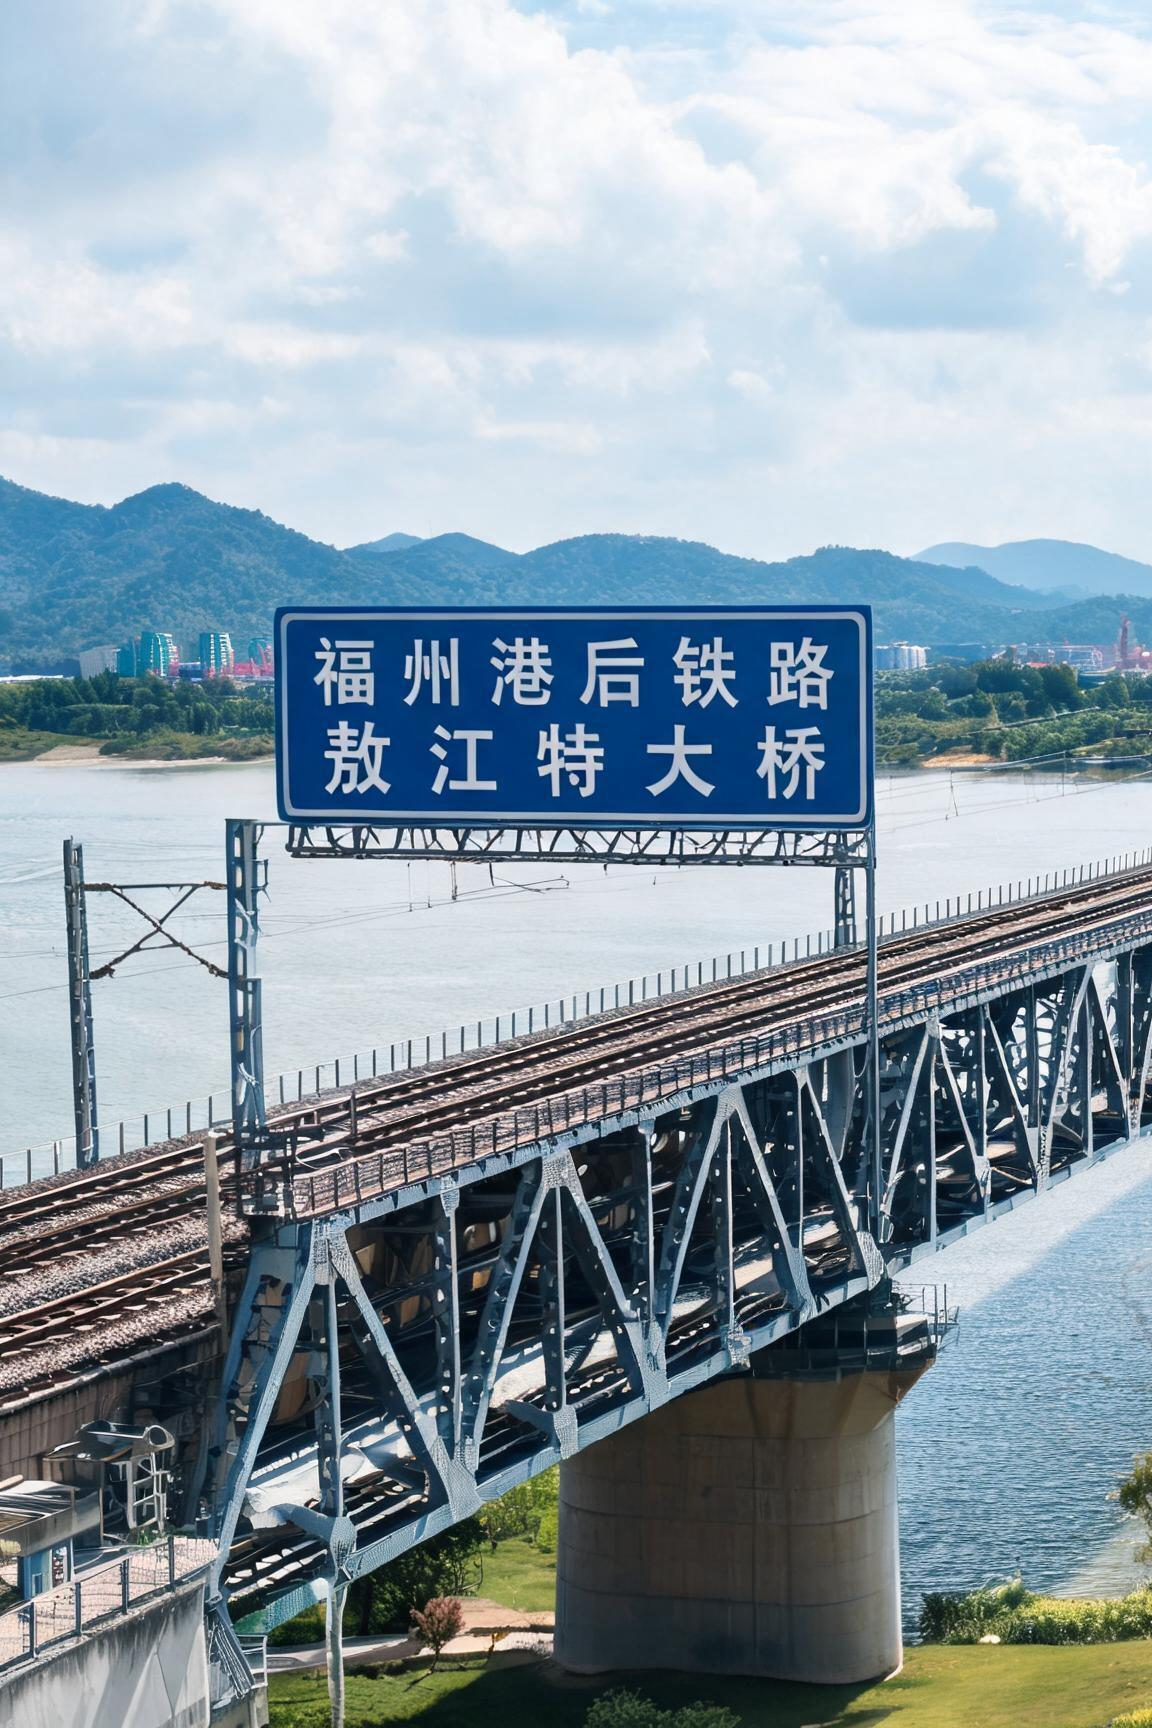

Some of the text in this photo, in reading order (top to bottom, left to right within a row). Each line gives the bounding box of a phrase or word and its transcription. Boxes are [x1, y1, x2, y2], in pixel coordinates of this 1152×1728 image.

[313, 636, 835, 710] 福州港后铁路
[324, 720, 826, 800] 敖江特大桥
